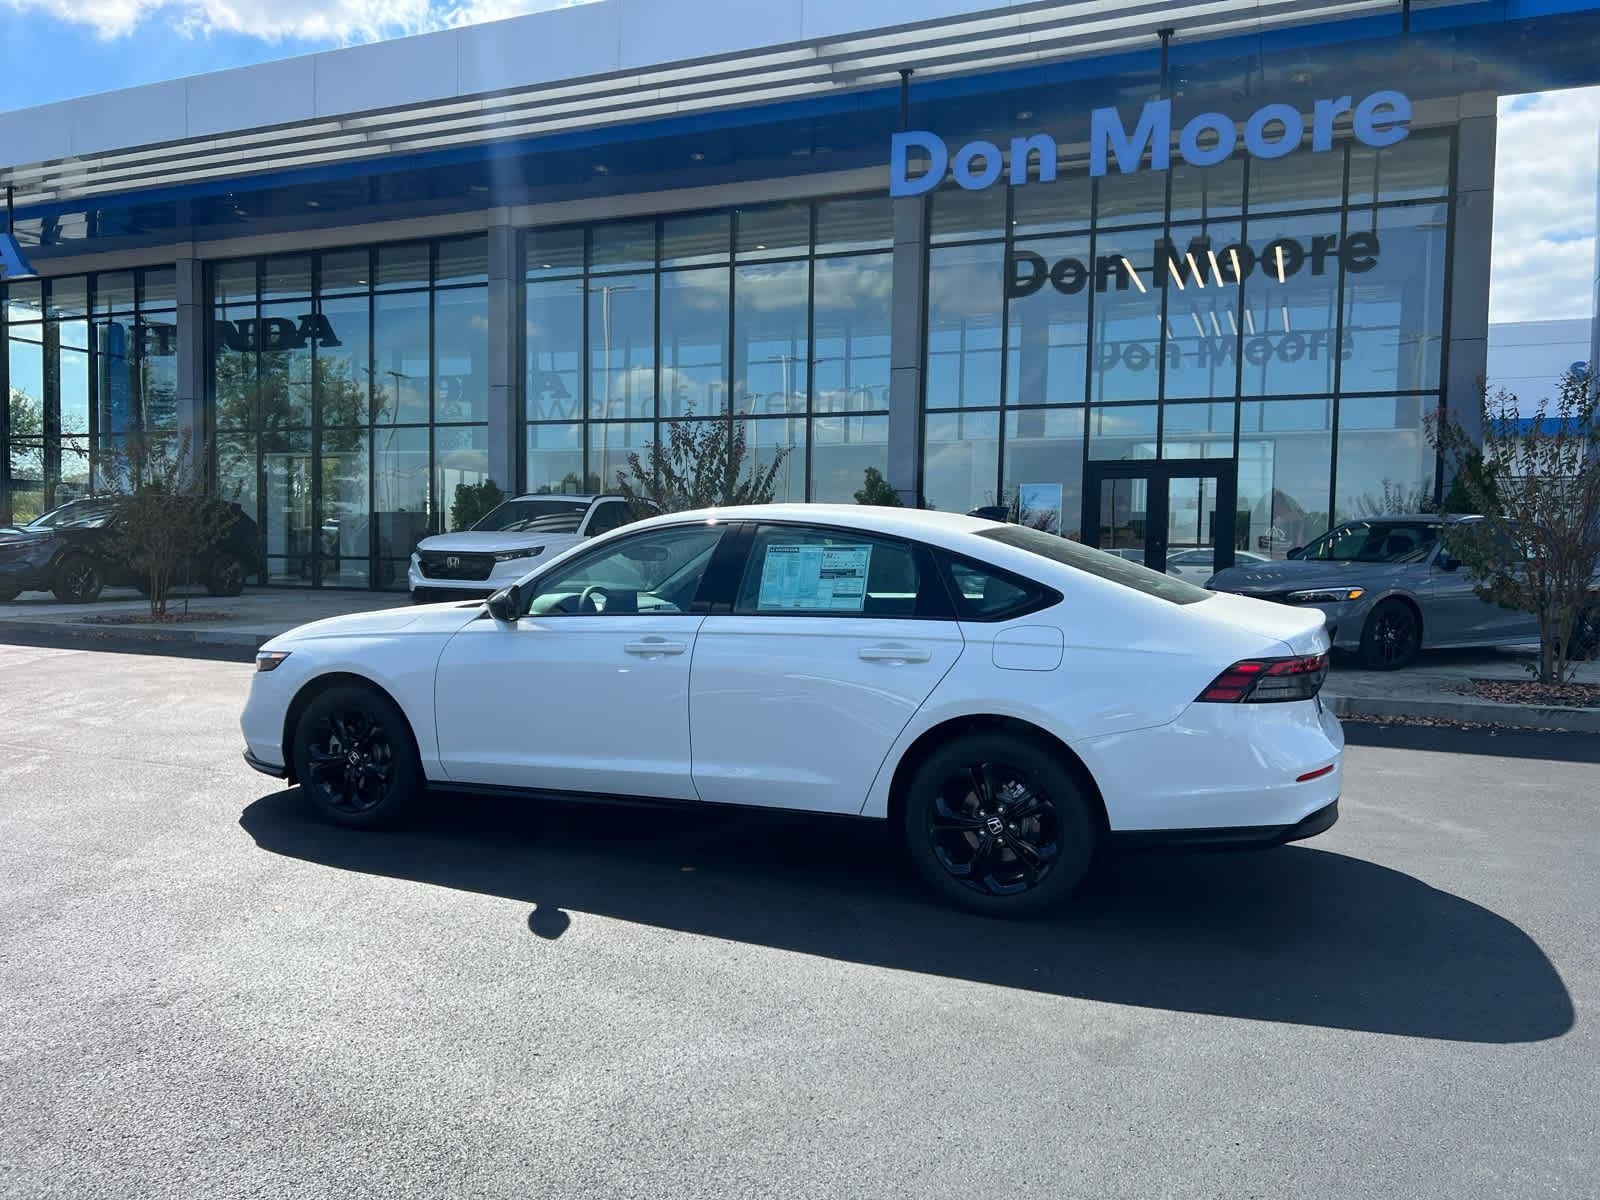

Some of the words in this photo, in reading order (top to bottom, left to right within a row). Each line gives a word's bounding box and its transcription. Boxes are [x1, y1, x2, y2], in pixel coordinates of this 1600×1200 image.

[889, 130, 1057, 198] Don
[1090, 90, 1413, 177] Moore
[1008, 249, 1130, 299] Don
[1152, 231, 1381, 288] Moore
